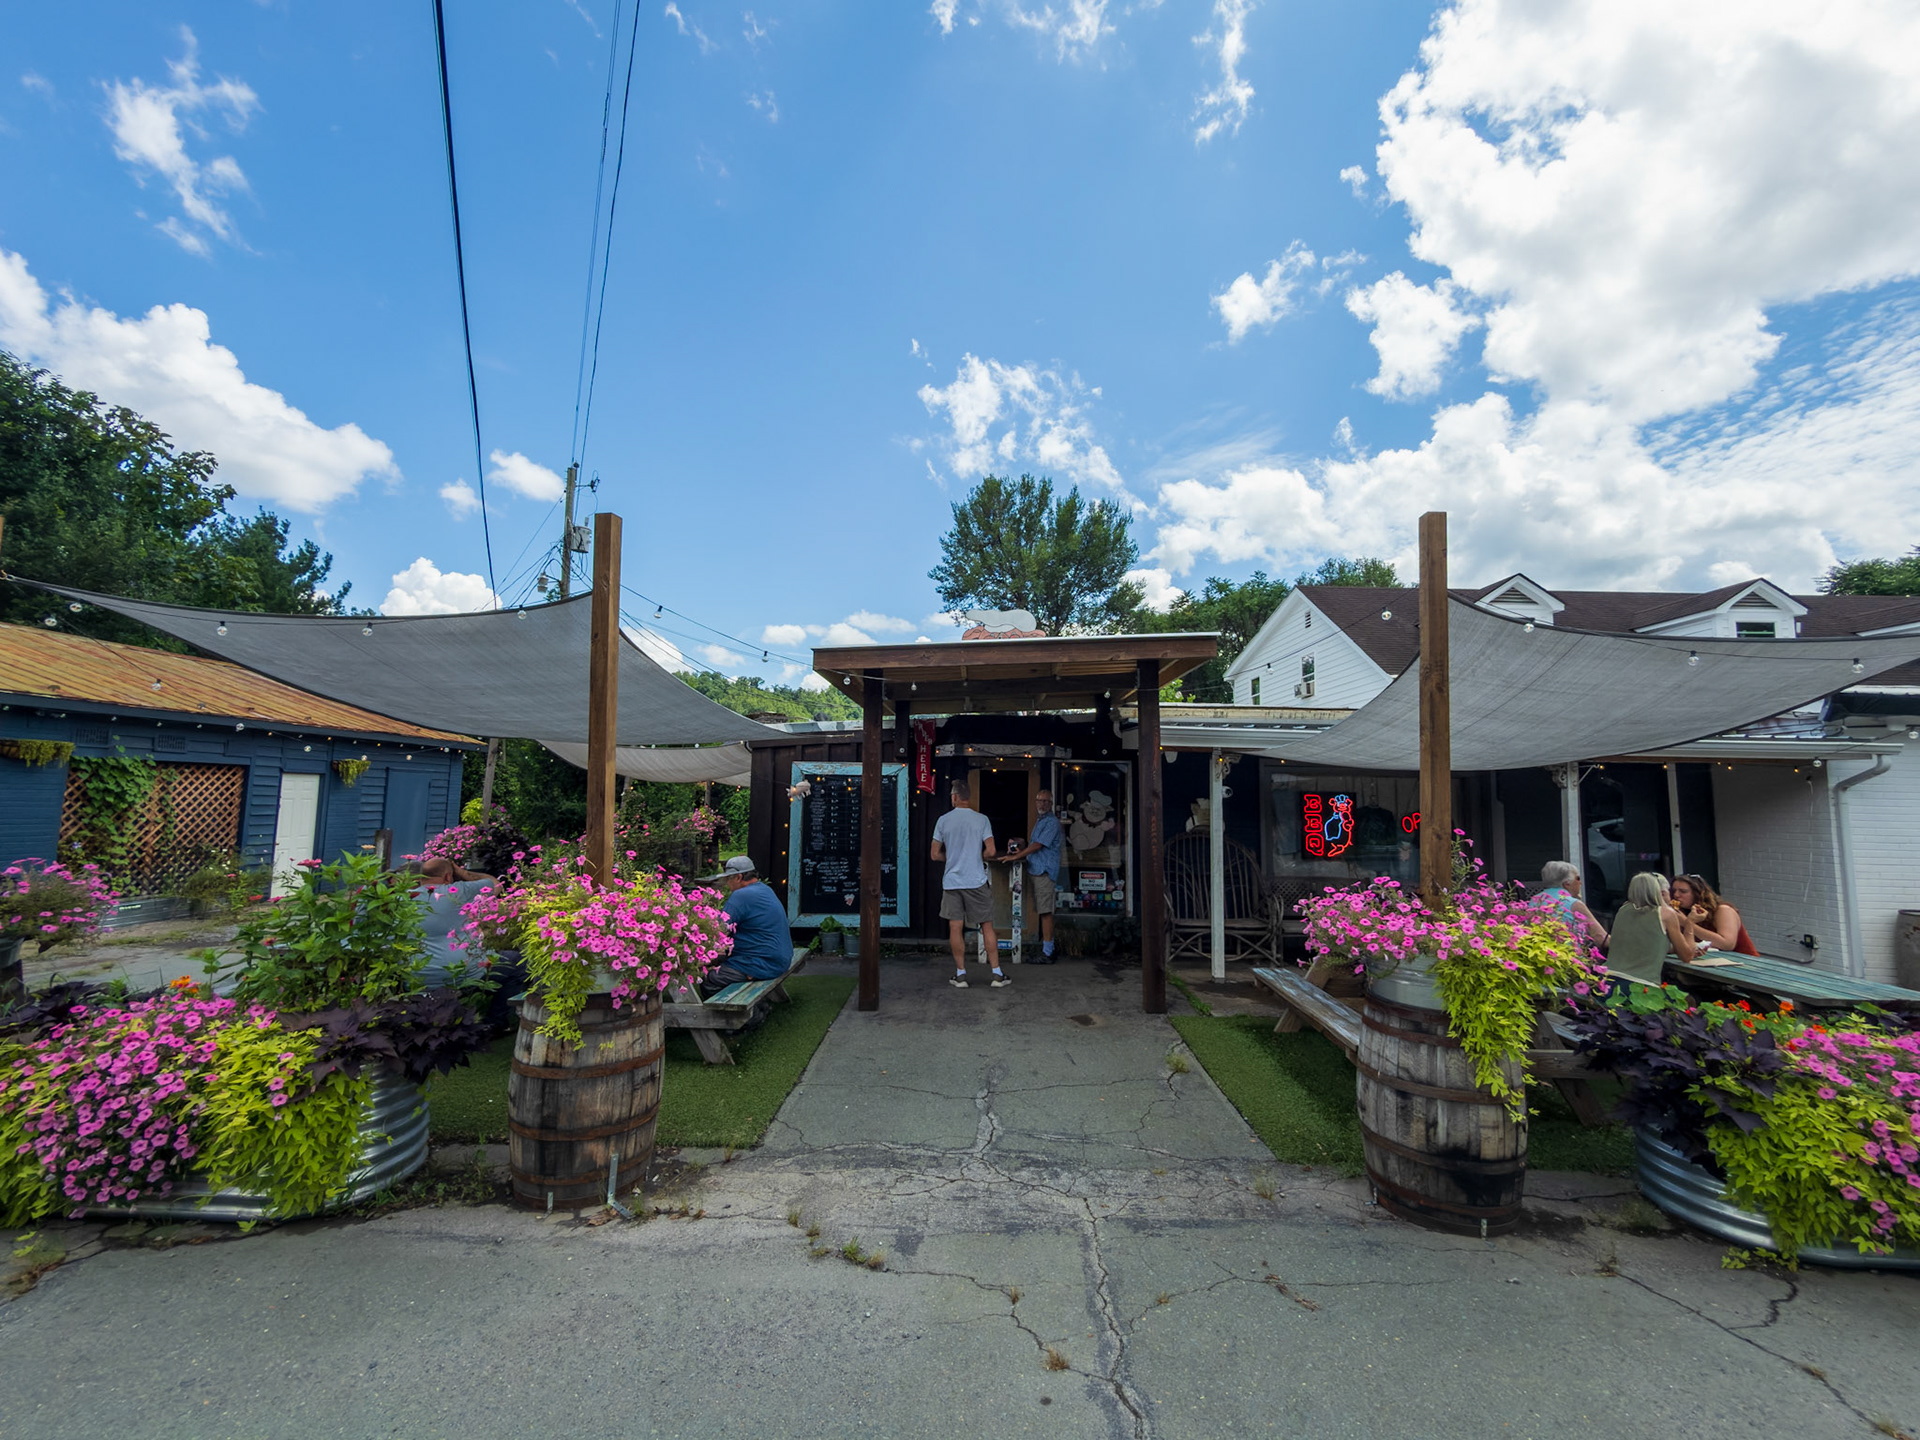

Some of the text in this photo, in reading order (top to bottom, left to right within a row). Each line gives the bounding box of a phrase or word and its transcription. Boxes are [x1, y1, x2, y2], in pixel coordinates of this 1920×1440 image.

[914, 719, 933, 745] ORDER
[920, 744, 928, 782] HERE
[1303, 794, 1325, 857] BBQ
[1401, 812, 1421, 834] OP
